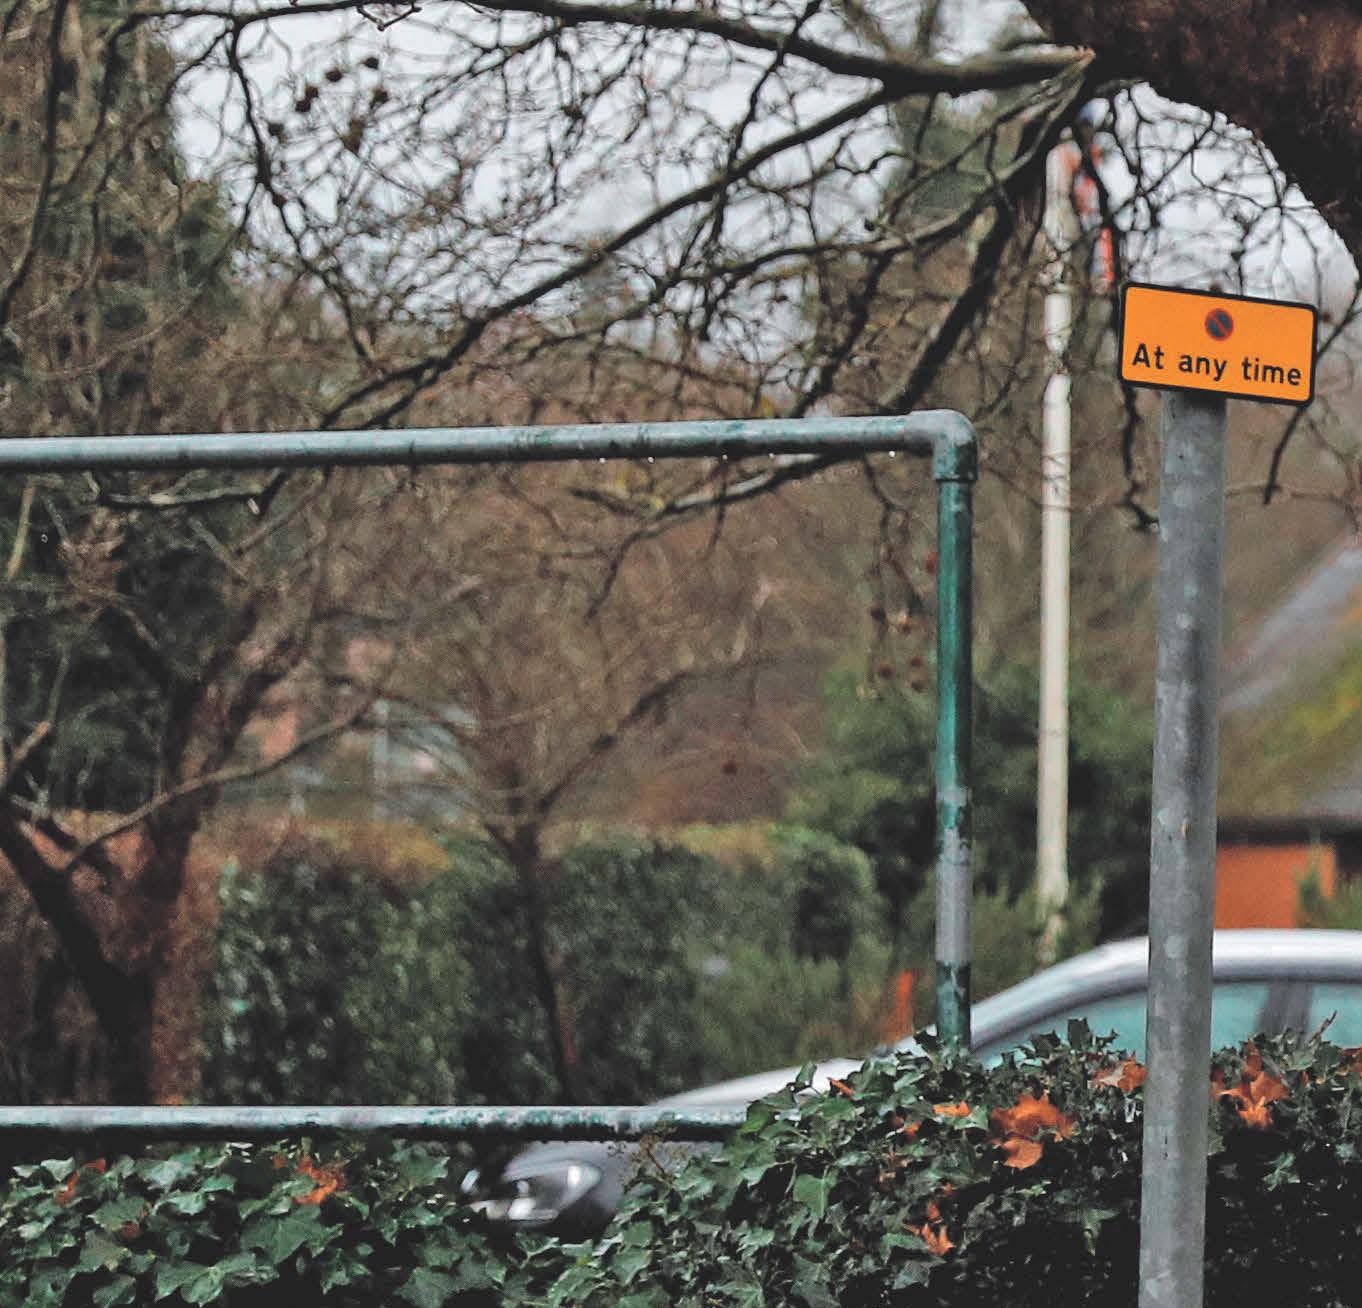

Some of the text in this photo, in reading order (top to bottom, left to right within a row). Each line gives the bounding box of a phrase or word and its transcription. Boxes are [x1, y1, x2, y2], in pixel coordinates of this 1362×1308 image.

[1132, 342, 1302, 386] At any time
